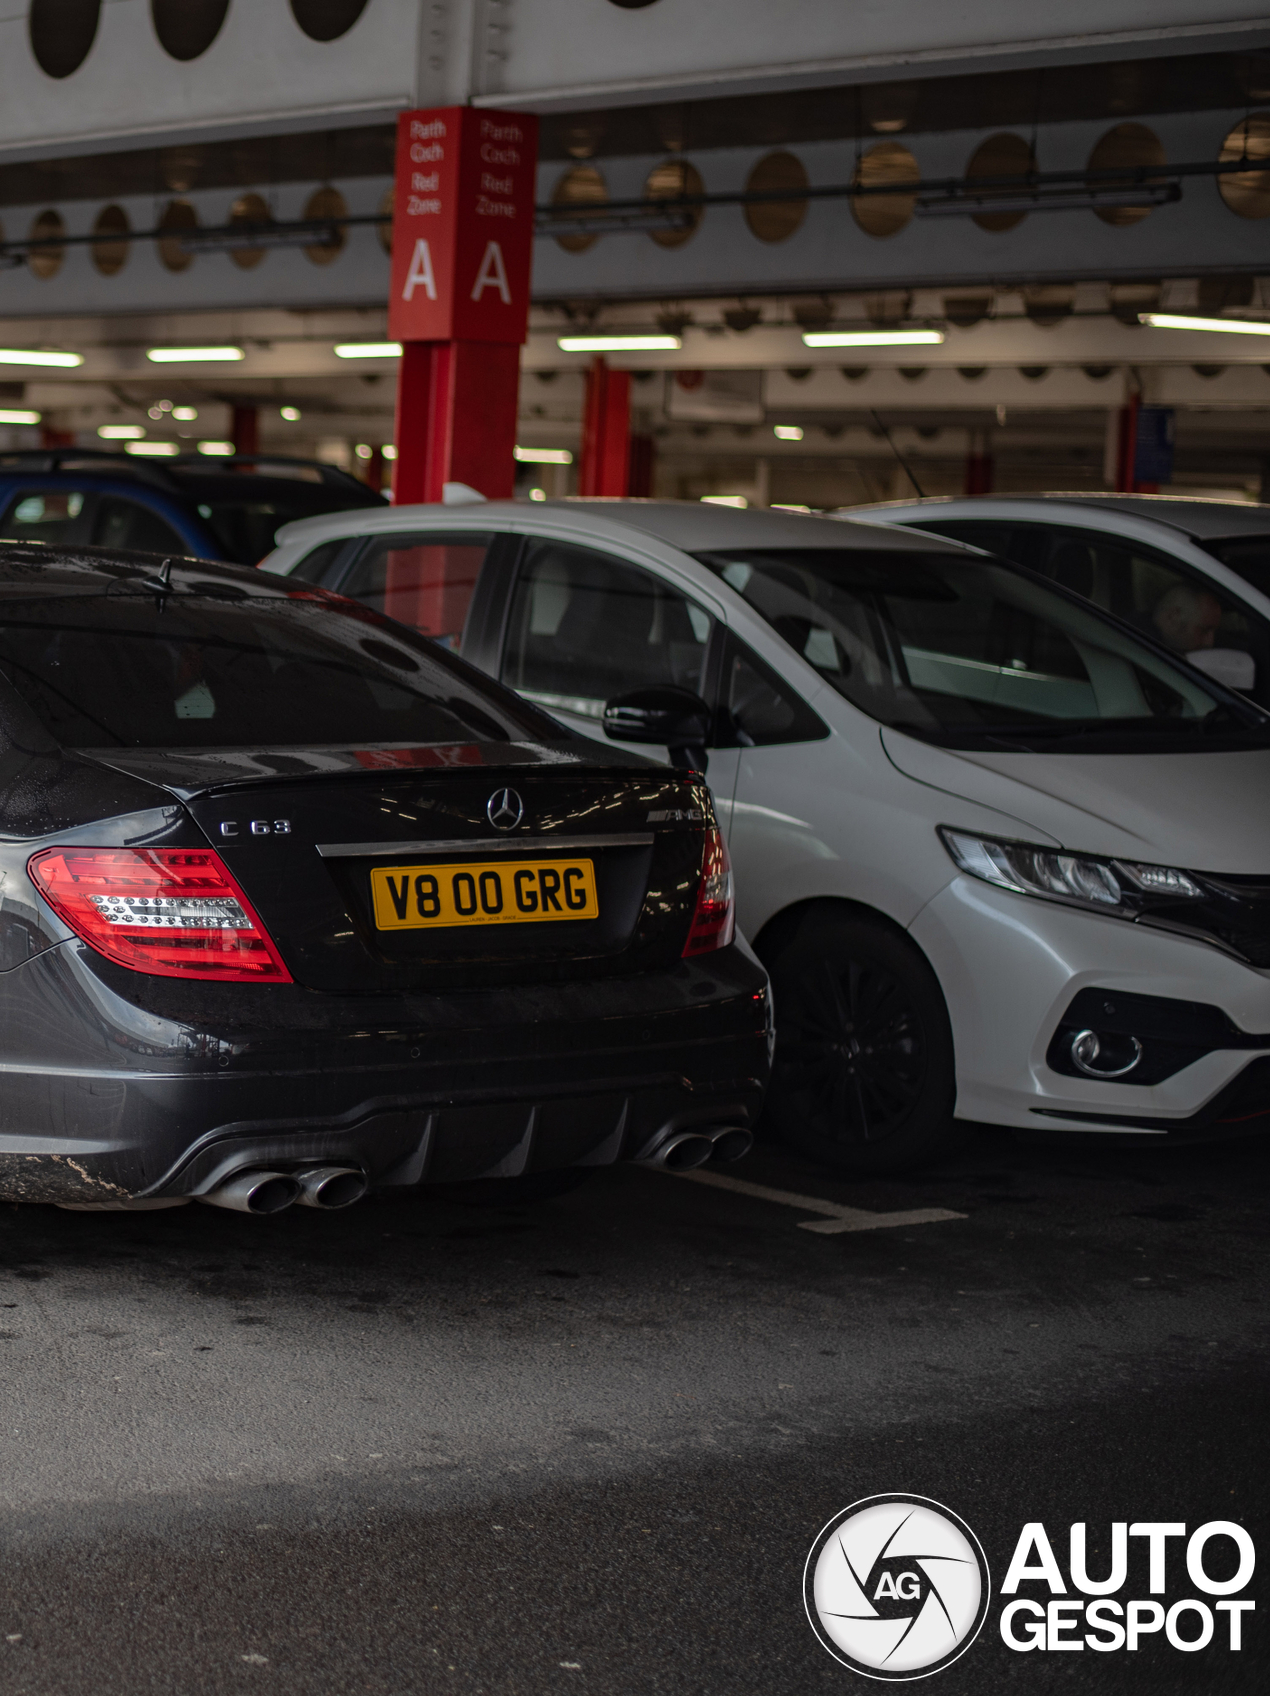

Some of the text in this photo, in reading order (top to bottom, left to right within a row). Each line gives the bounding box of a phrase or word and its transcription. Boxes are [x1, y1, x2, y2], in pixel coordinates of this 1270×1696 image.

[411, 171, 440, 192] Red
[481, 172, 514, 195] Red
[407, 195, 443, 216] Zone
[475, 194, 517, 219] Zone
[402, 238, 437, 302] A
[470, 240, 512, 305] A
[220, 819, 292, 836] C 63
[385, 874, 441, 920] V8
[513, 867, 587, 913] GRG
